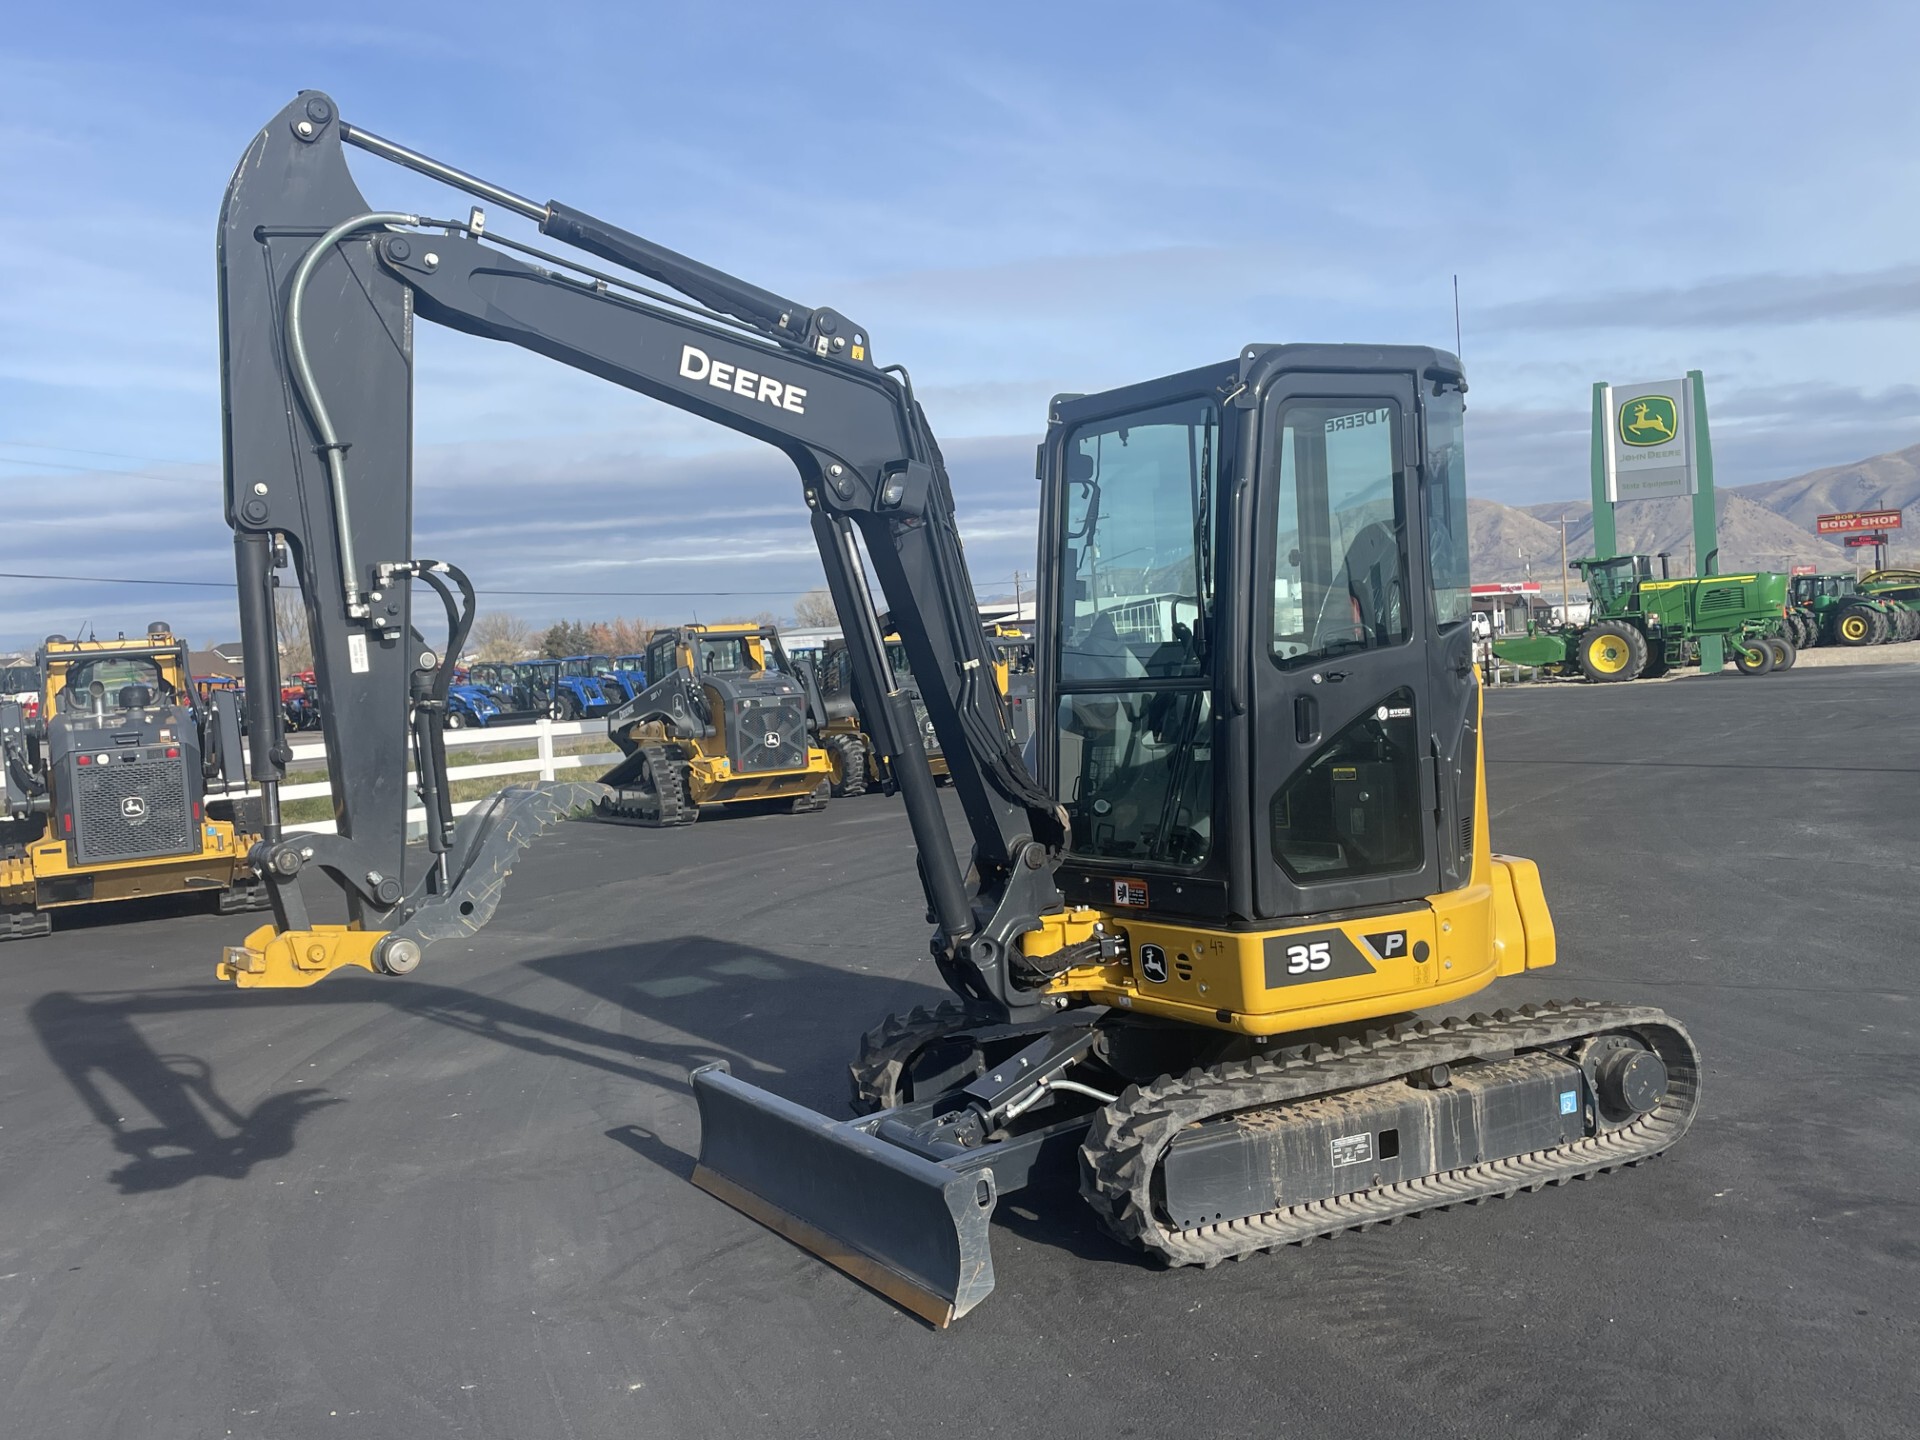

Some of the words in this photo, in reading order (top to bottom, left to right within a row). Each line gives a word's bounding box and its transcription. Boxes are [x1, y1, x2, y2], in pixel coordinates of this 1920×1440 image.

[680, 345, 807, 414] DEERE
[1620, 453, 1646, 462] JOHN
[1647, 449, 1681, 459] DEERE
[1642, 479, 1681, 489] Equipment
[1820, 519, 1857, 529] BODY
[1861, 515, 1898, 526] SHOP
[1385, 933, 1404, 956] P
[1286, 941, 1332, 975] 35
